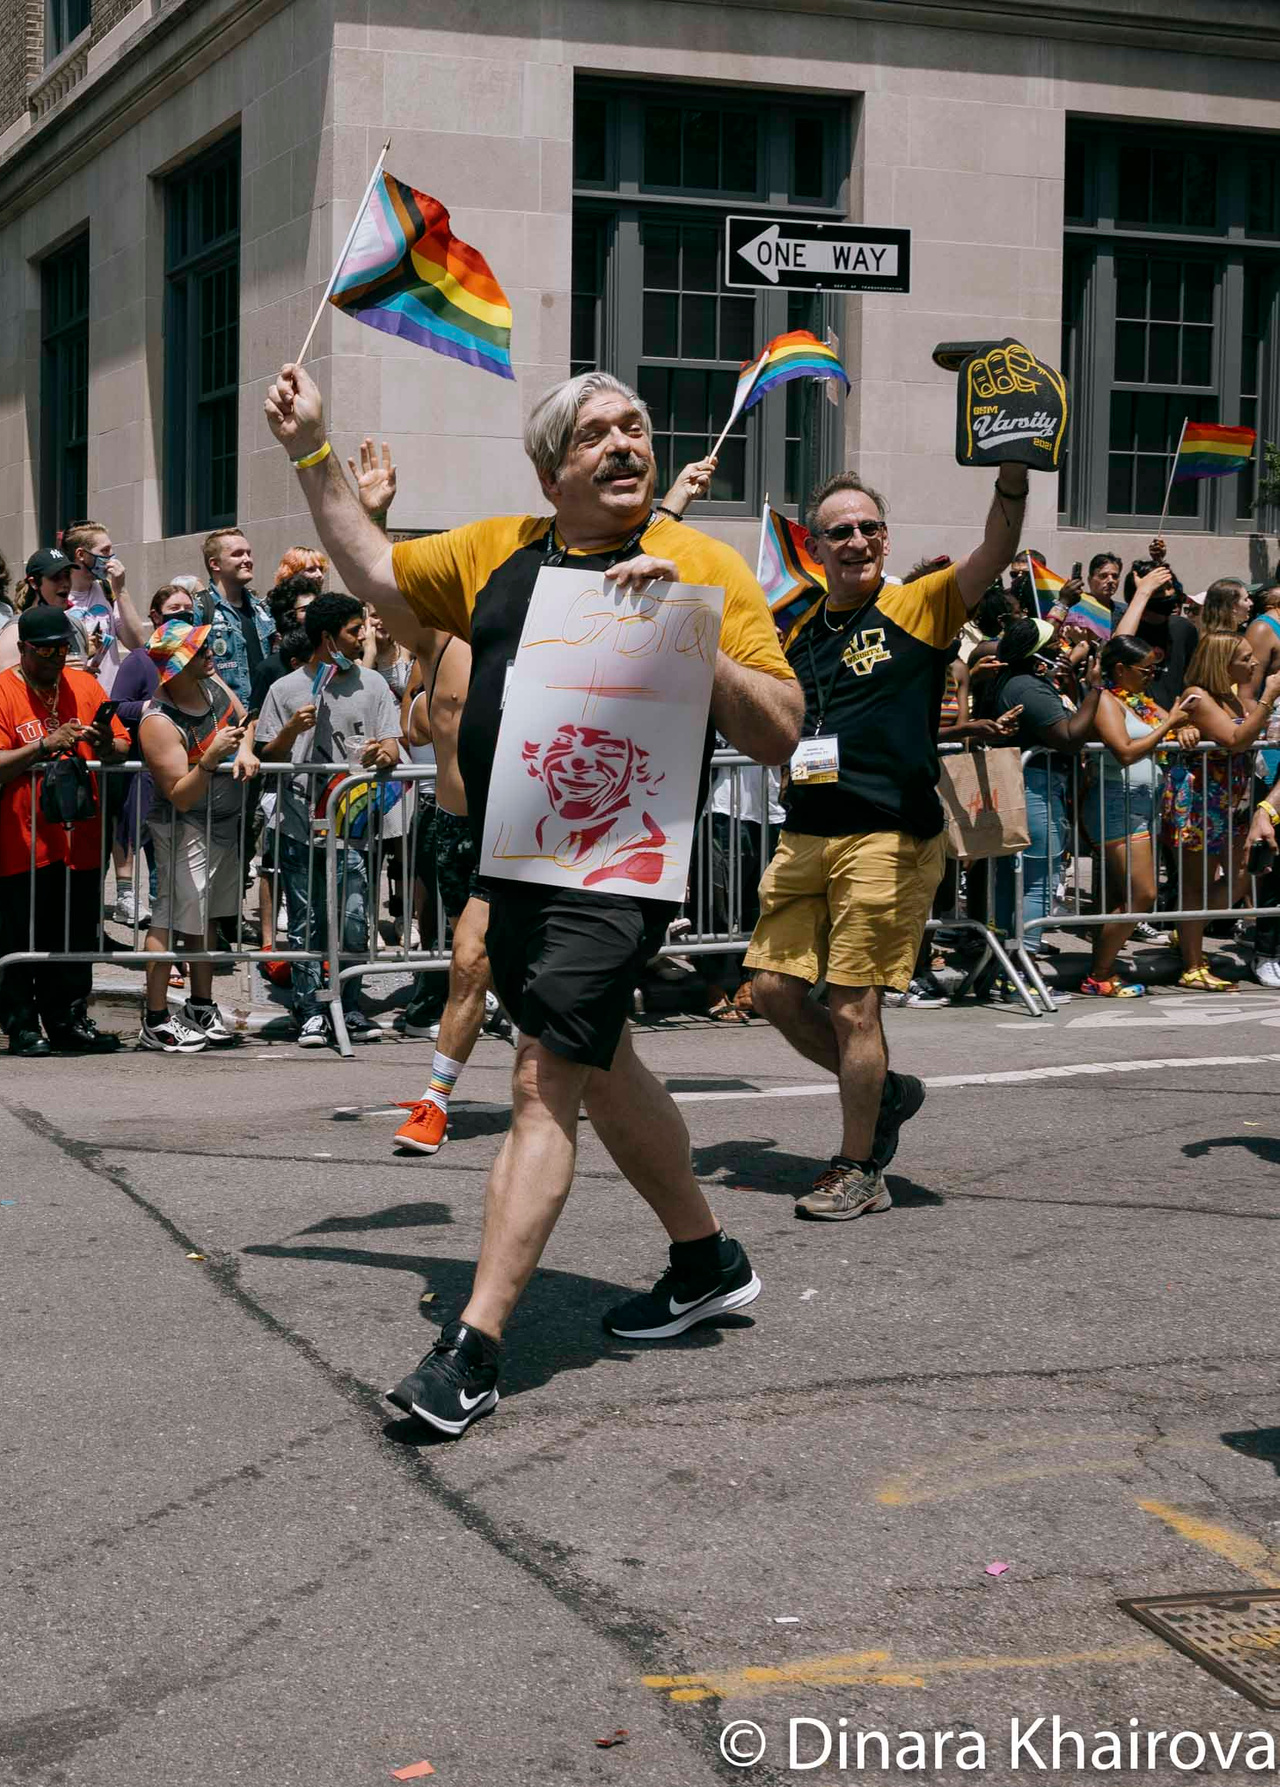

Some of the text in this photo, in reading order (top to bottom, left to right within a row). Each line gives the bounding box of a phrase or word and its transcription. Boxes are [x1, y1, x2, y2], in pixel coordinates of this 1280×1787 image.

[757, 240, 887, 272] ONE WAY
[972, 409, 1058, 438] Varsity
[973, 405, 999, 416] GSM
[1033, 437, 1053, 451] 2021
[521, 589, 718, 662] LGBTQ
